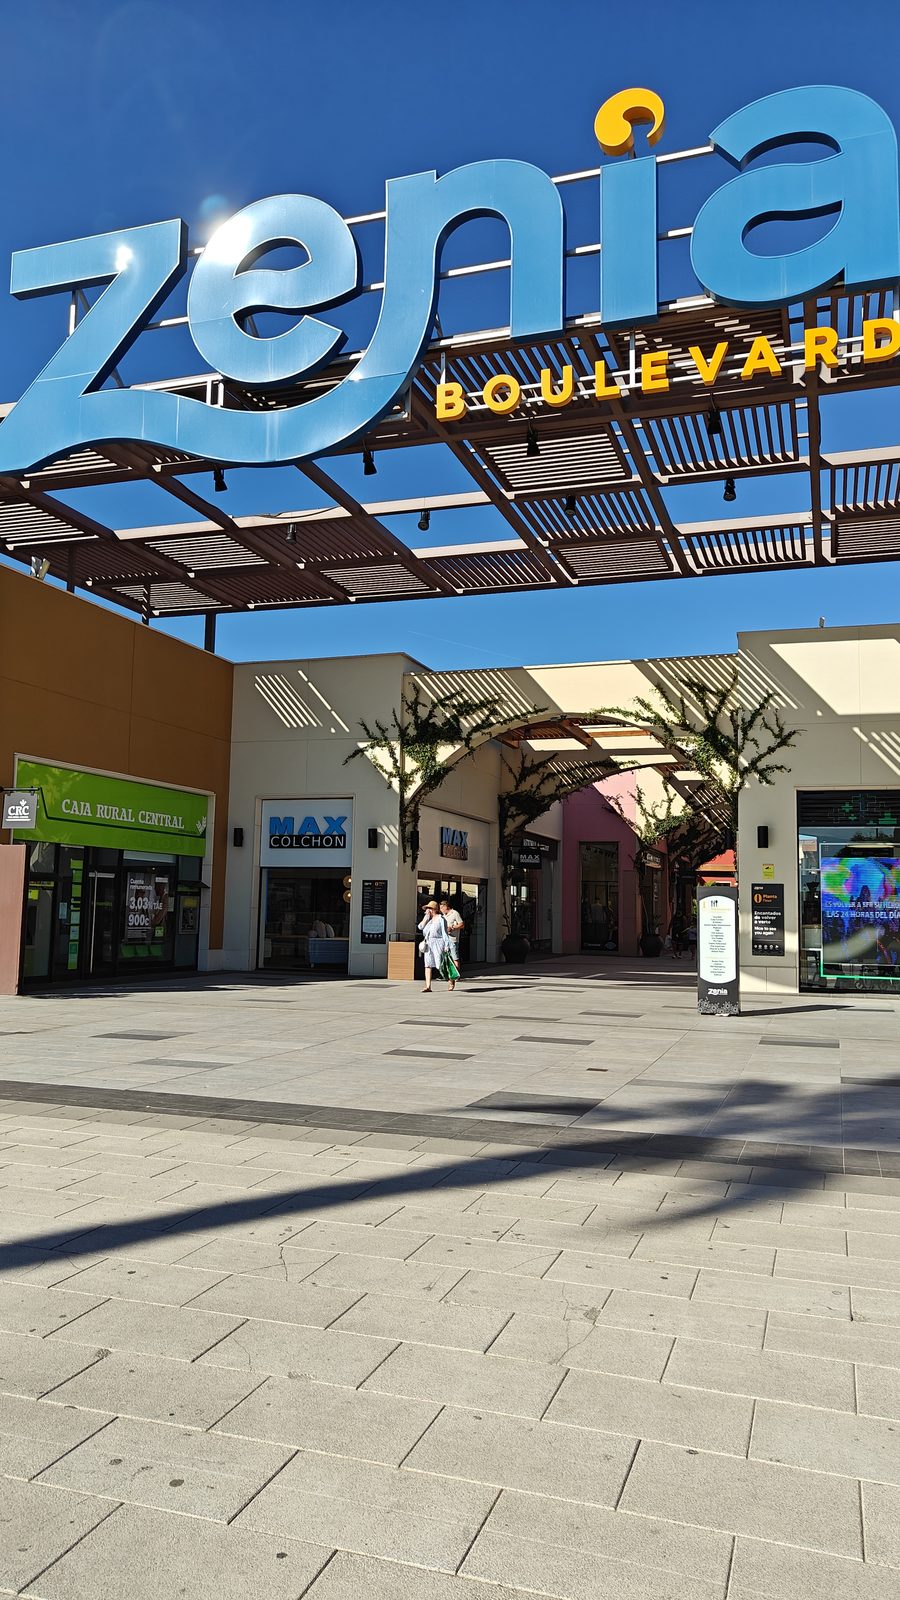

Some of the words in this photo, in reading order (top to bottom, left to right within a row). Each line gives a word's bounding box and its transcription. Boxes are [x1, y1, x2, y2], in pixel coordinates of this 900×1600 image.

[0, 85, 900, 475] zenia
[436, 318, 900, 422] BOULEVARD
[7, 805, 30, 816] CRC
[61, 799, 93, 817] CAJA
[96, 804, 135, 823] RURAL
[138, 811, 185, 829] CENTRAL
[269, 816, 348, 835] MAX
[270, 835, 345, 848] COLCHON
[441, 827, 469, 849] MAX
[850, 911, 874, 919] HORAS
[874, 911, 888, 919] DEL
[707, 987, 728, 996] zenia
